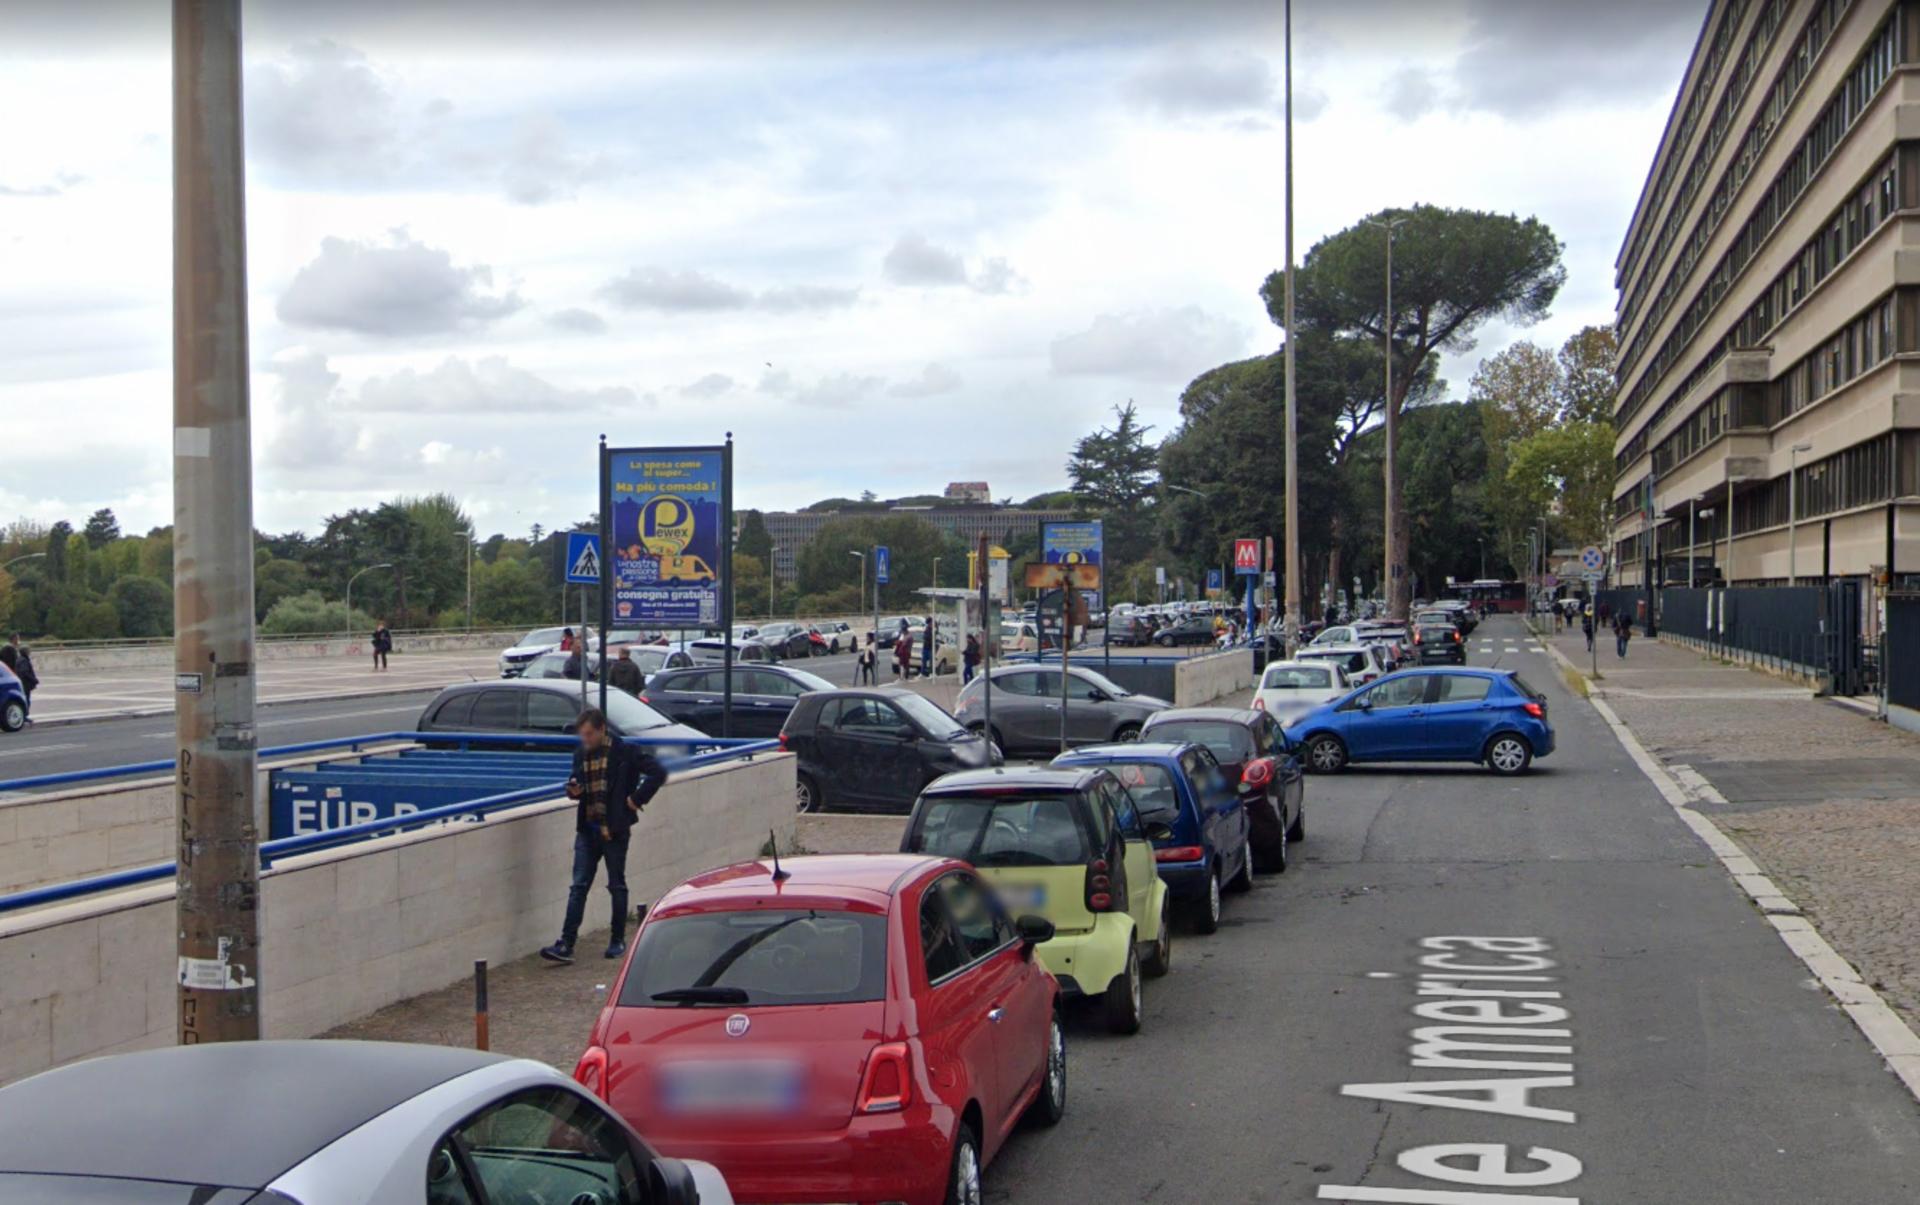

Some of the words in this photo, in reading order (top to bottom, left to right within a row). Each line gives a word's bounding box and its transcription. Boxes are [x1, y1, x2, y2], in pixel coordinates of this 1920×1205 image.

[644, 462, 673, 472] spesa
[616, 482, 633, 492] Ma
[636, 481, 656, 493] più
[659, 481, 709, 492] comoda
[644, 498, 689, 538] Pewex
[1237, 544, 1255, 561] M
[616, 590, 669, 601] consegna
[671, 589, 715, 601] gratuita
